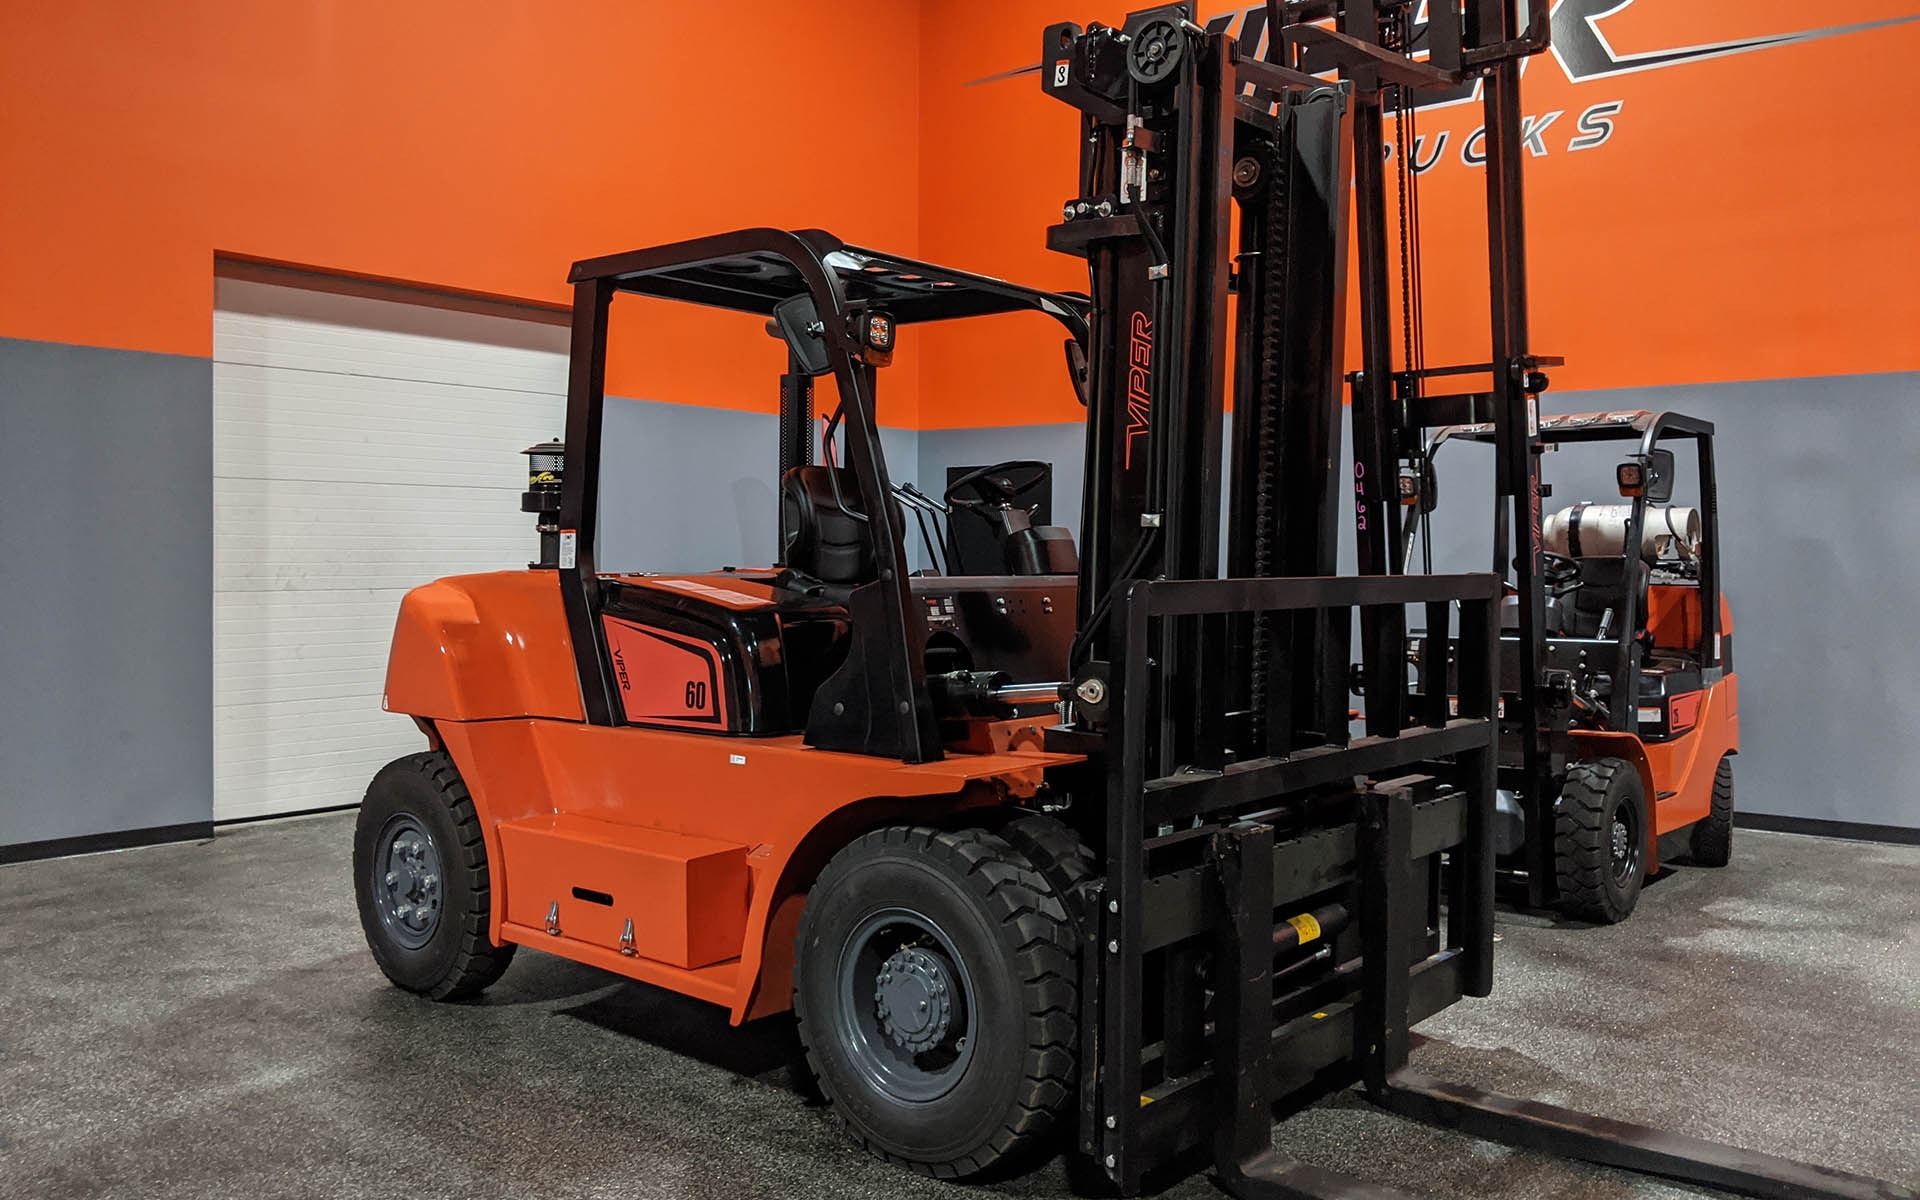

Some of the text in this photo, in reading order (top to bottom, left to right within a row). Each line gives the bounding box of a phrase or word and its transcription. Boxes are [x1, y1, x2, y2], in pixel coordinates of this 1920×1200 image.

[1126, 311, 1152, 470] VIPER
[614, 640, 631, 692] VIPER
[685, 681, 706, 710] 60
